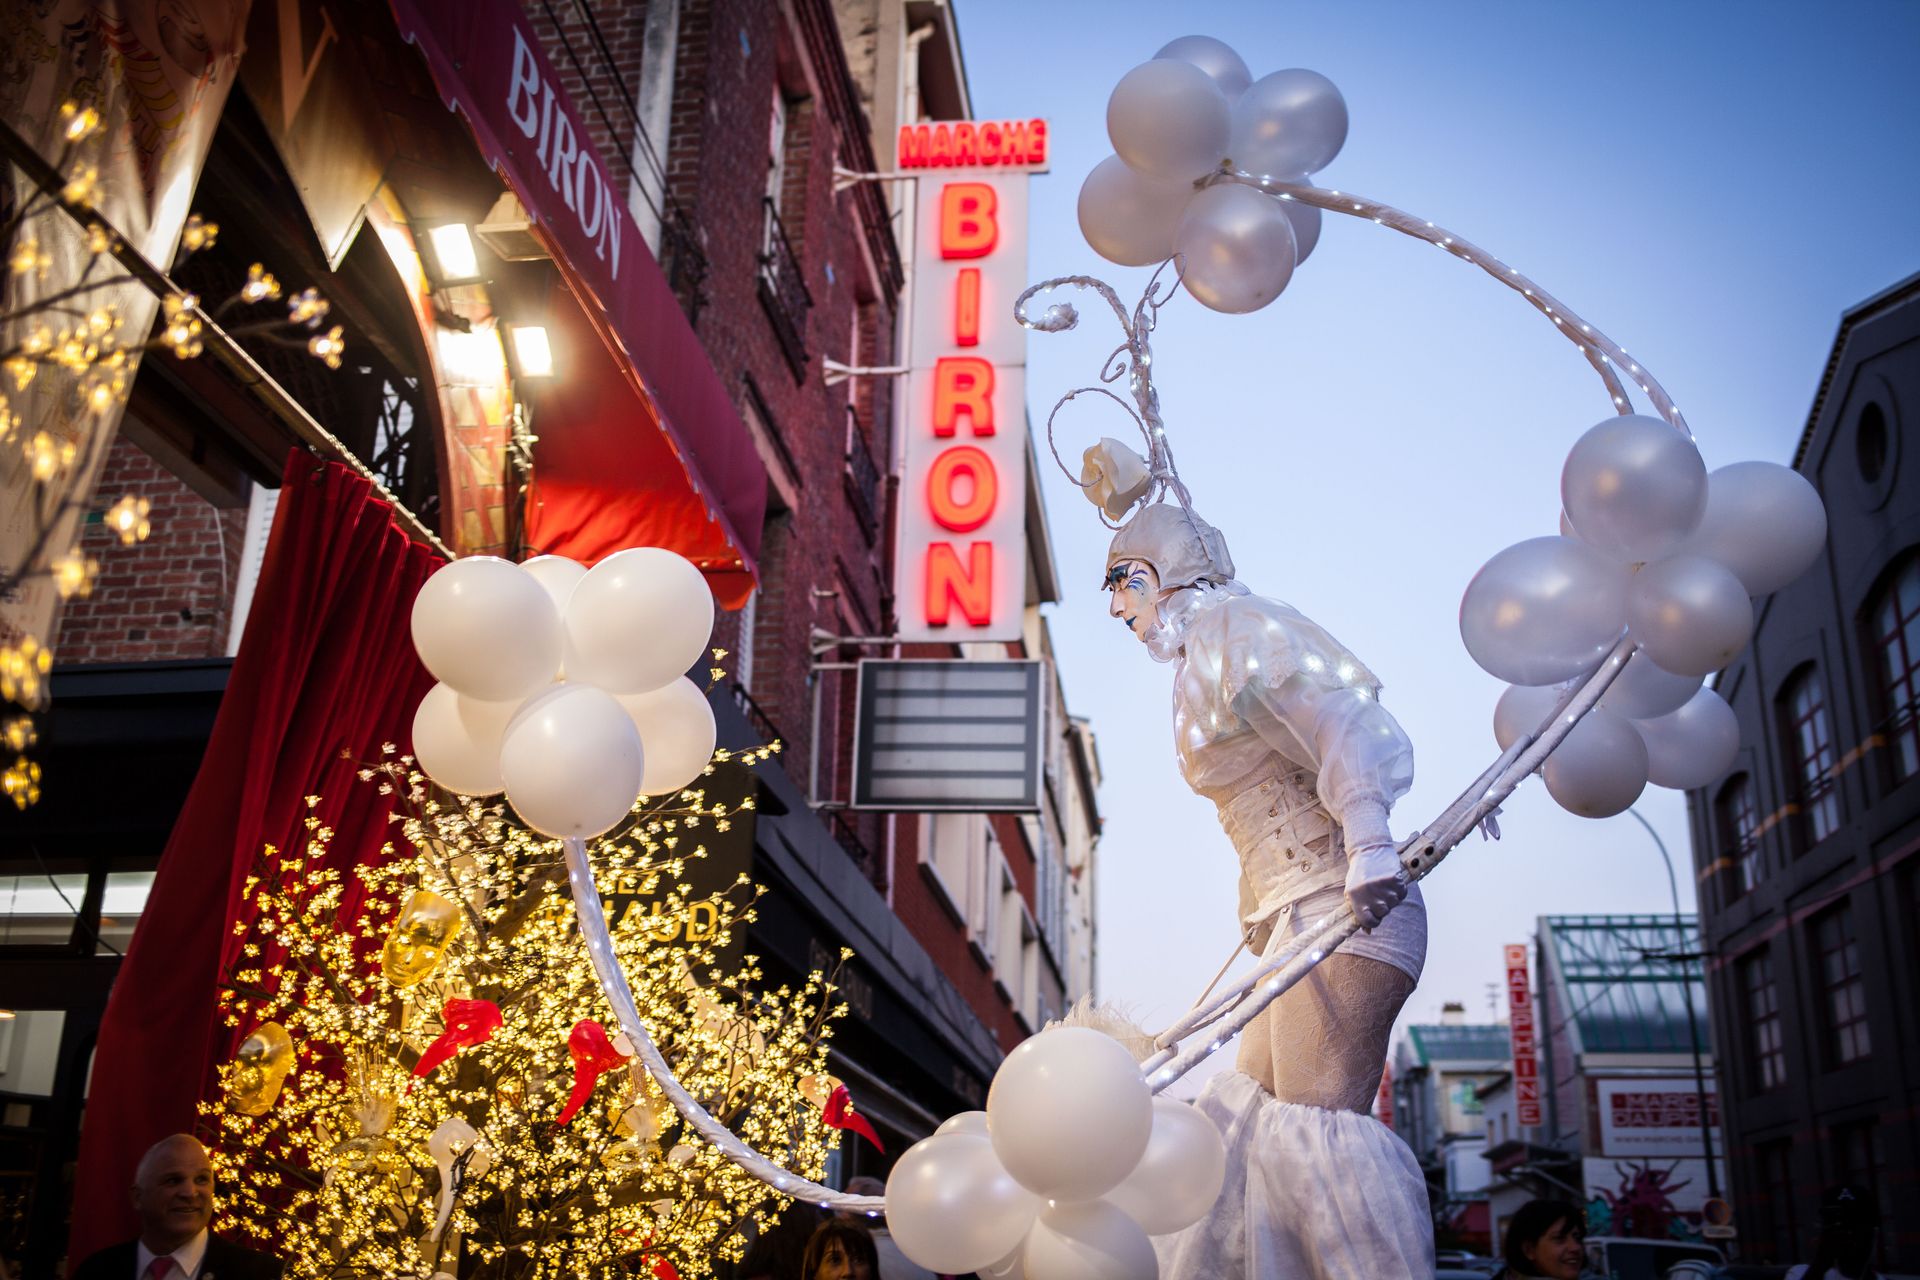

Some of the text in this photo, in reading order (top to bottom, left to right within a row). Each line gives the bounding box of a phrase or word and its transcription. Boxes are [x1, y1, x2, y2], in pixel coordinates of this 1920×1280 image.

[506, 23, 621, 281] BIRON
[925, 183, 998, 627] BIRON
[1506, 946, 1541, 1125] DAUPHINE
